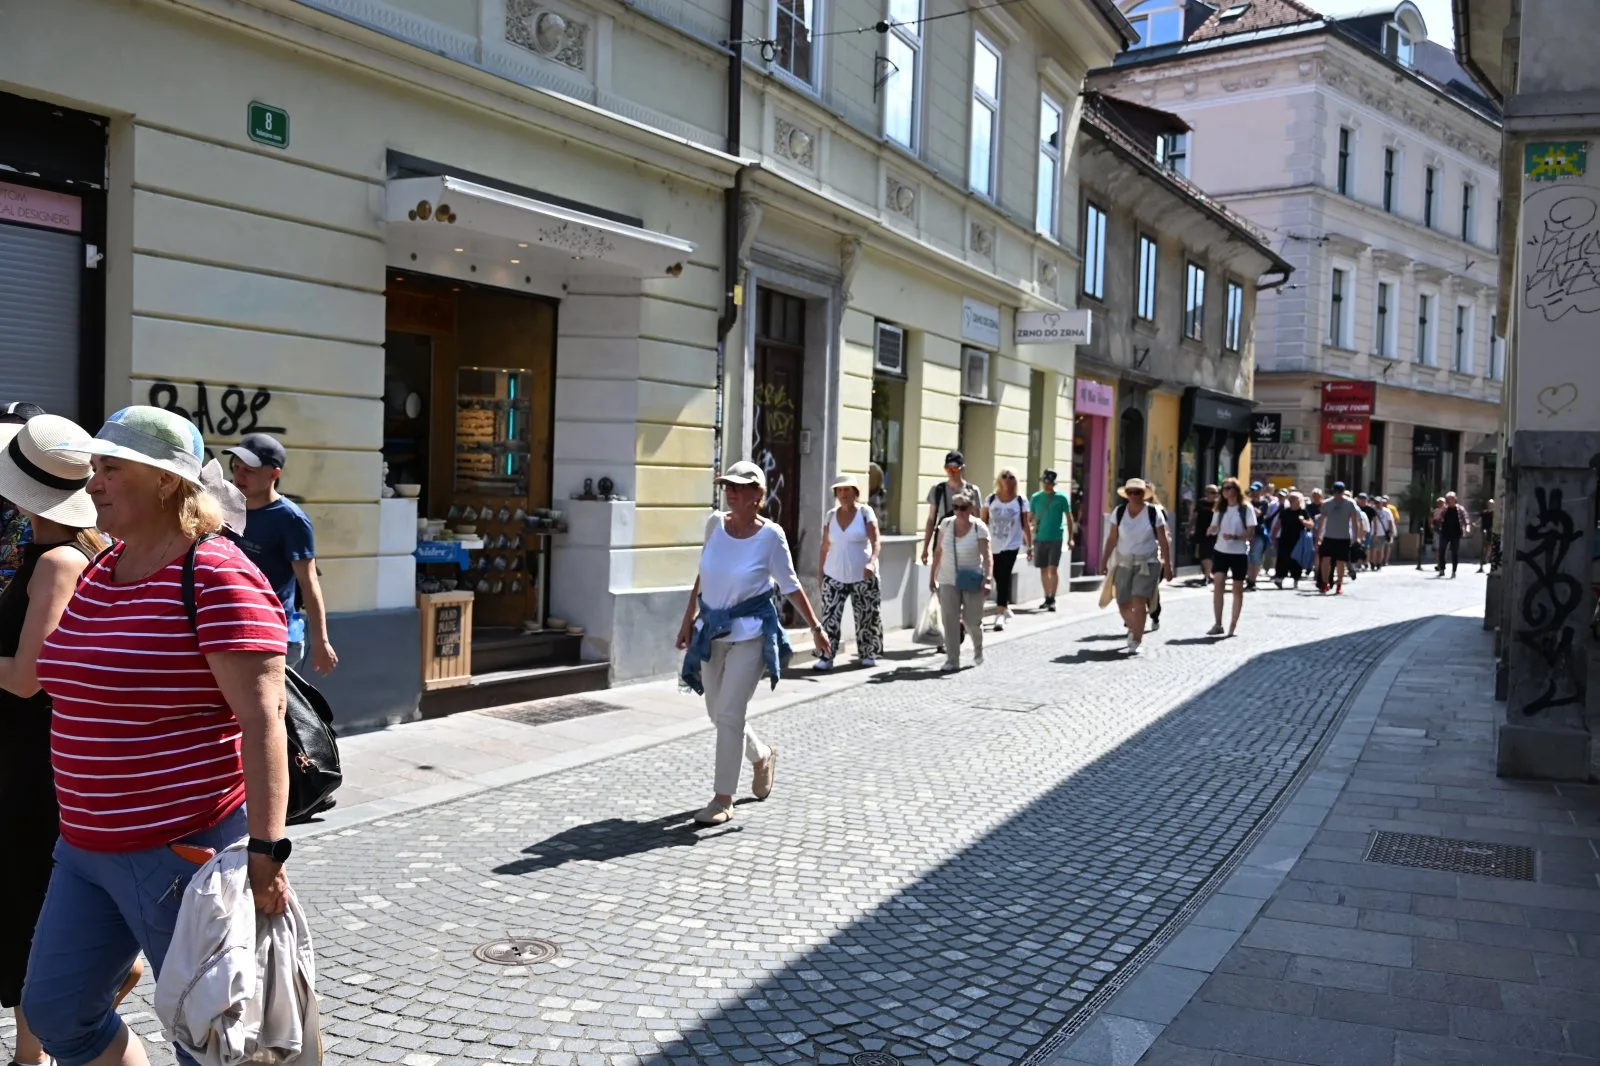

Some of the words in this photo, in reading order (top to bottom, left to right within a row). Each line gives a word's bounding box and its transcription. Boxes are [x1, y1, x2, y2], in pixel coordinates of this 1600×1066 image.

[265, 112, 272, 130] 8
[18, 206, 70, 226] DESIGNERS
[1017, 329, 1043, 338] ZRNO
[1044, 329, 1058, 337] DO
